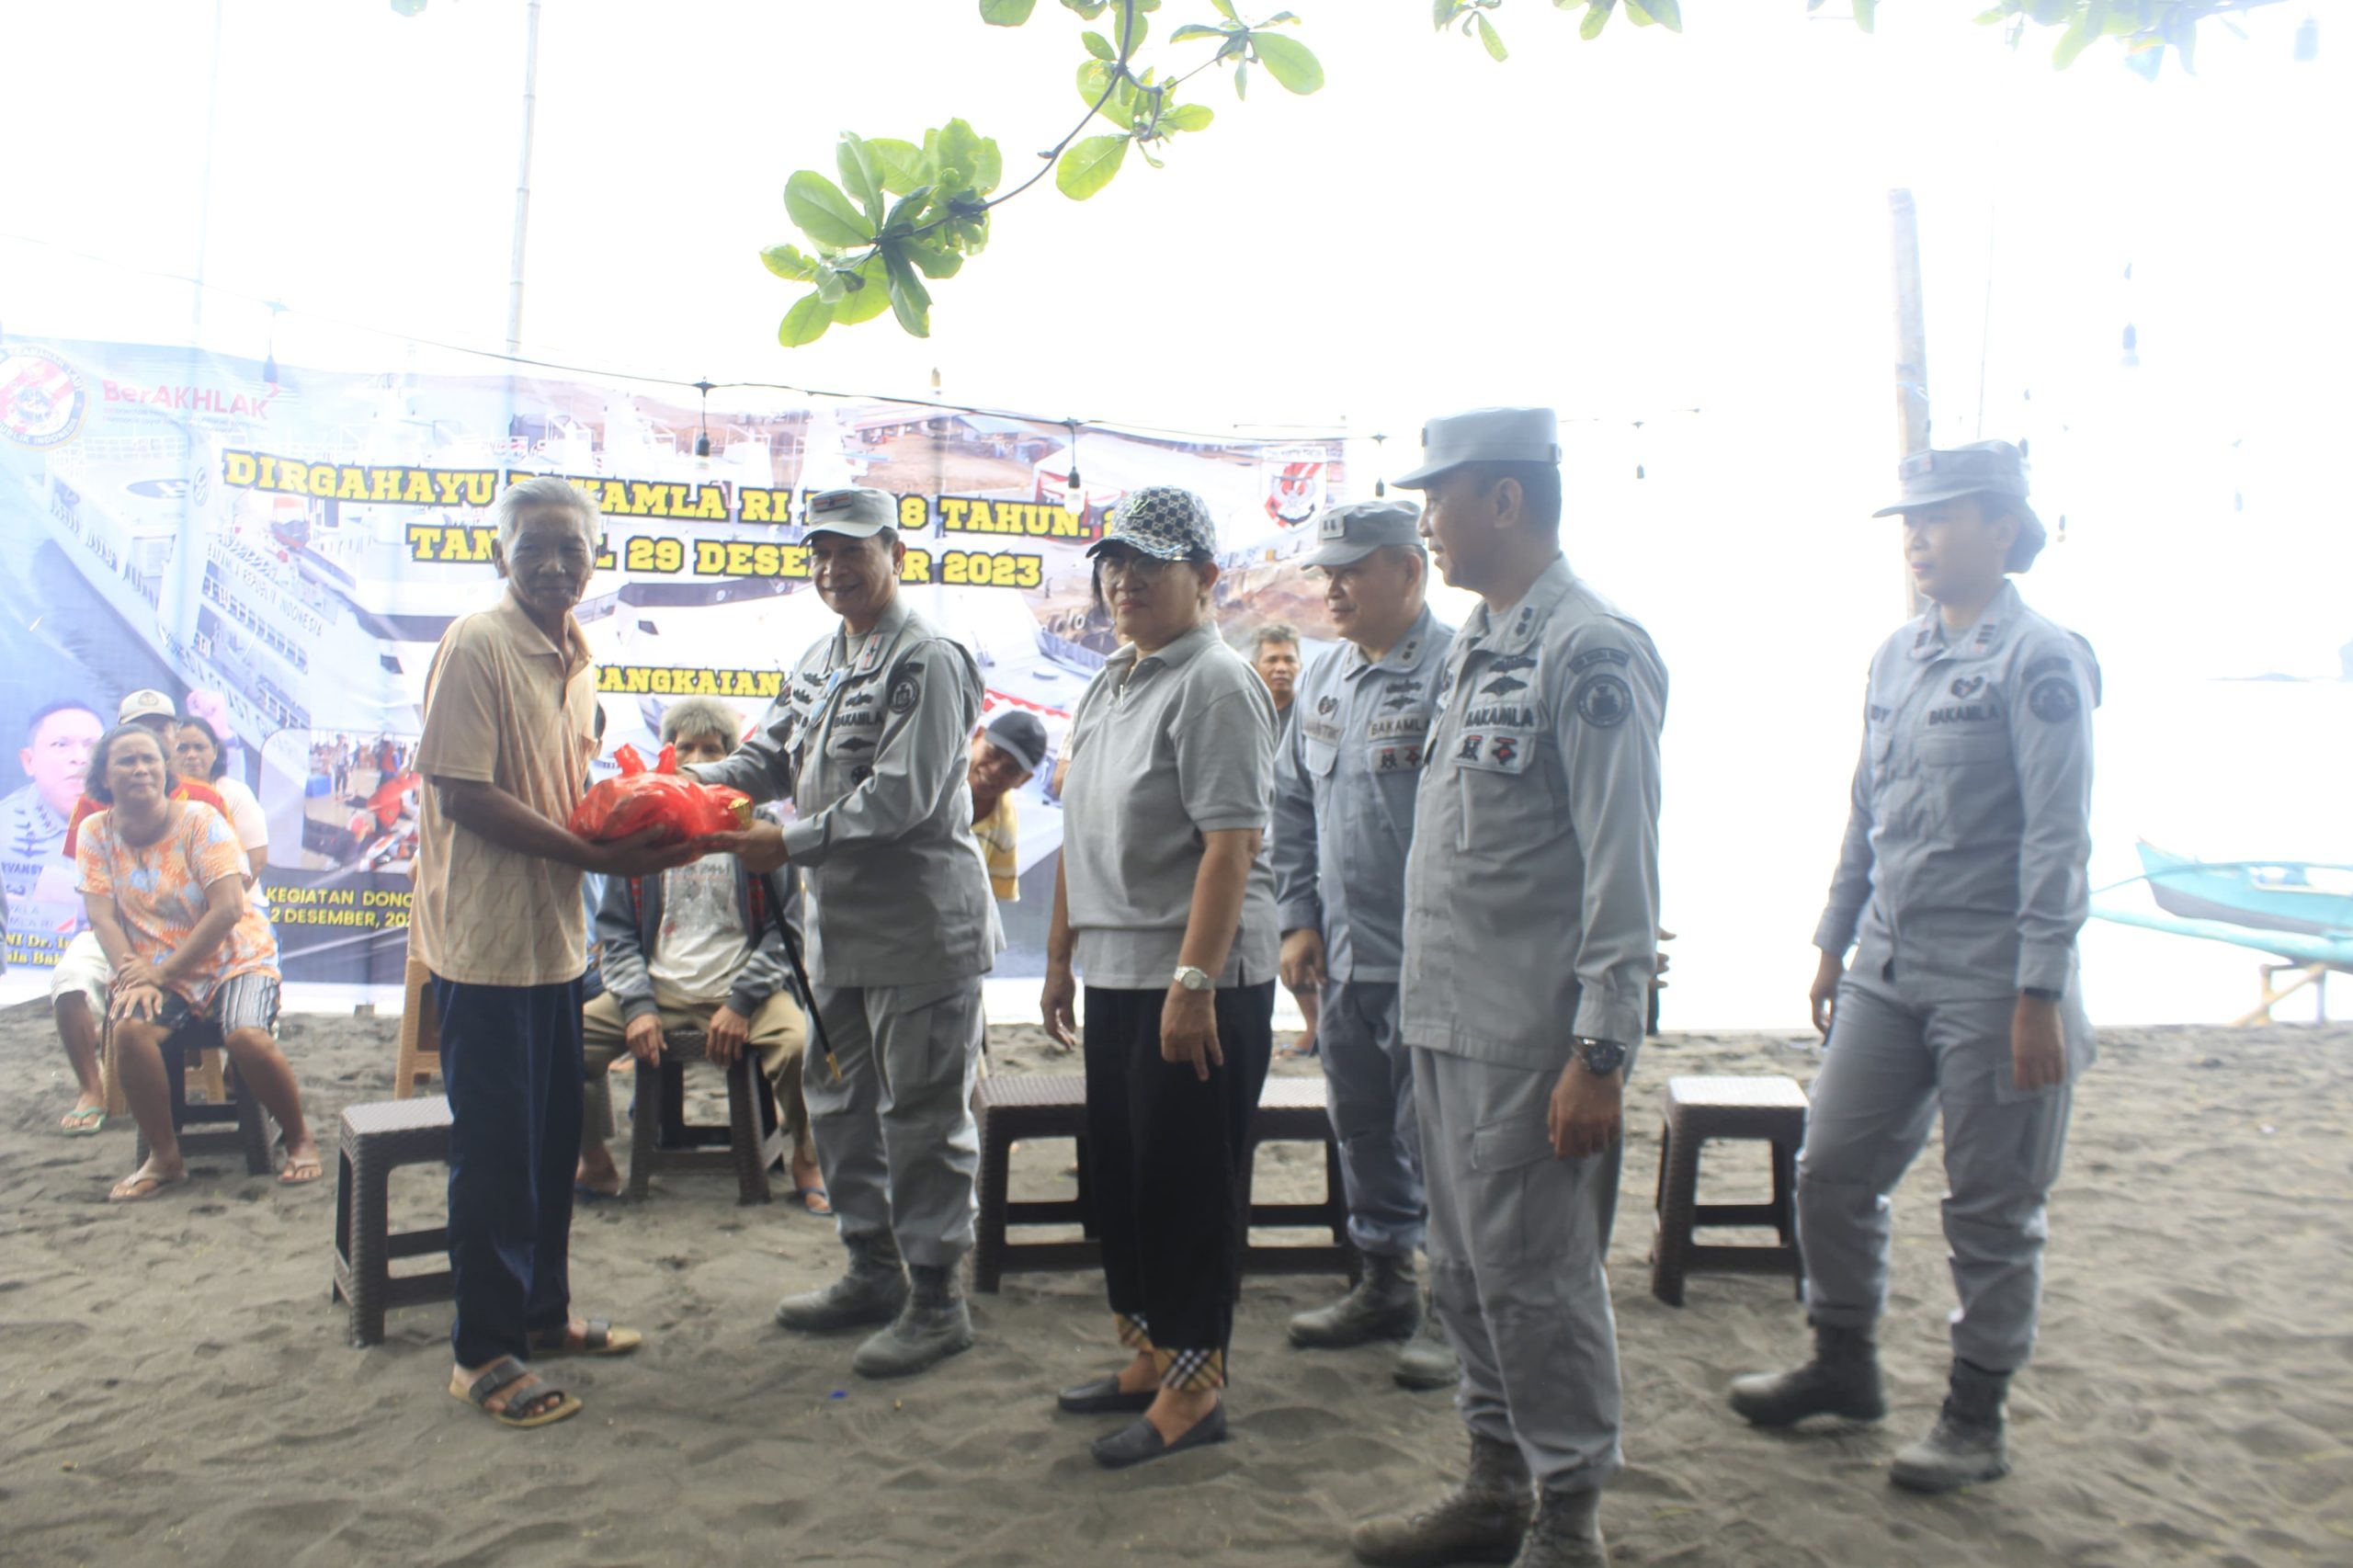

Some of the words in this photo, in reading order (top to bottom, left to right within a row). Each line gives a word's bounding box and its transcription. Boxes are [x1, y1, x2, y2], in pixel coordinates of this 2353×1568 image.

[103, 379, 269, 420] BerAKHLAK
[224, 449, 498, 506] DIRGAHAYU
[740, 487, 790, 525] RI
[938, 495, 1090, 539] TAHUN.
[406, 526, 616, 571] TANL
[627, 536, 684, 572] 29
[695, 538, 931, 584] DESER
[942, 550, 1042, 587] 2023
[267, 886, 355, 905] KEGIATAN
[284, 907, 380, 929] DESEMBER,
